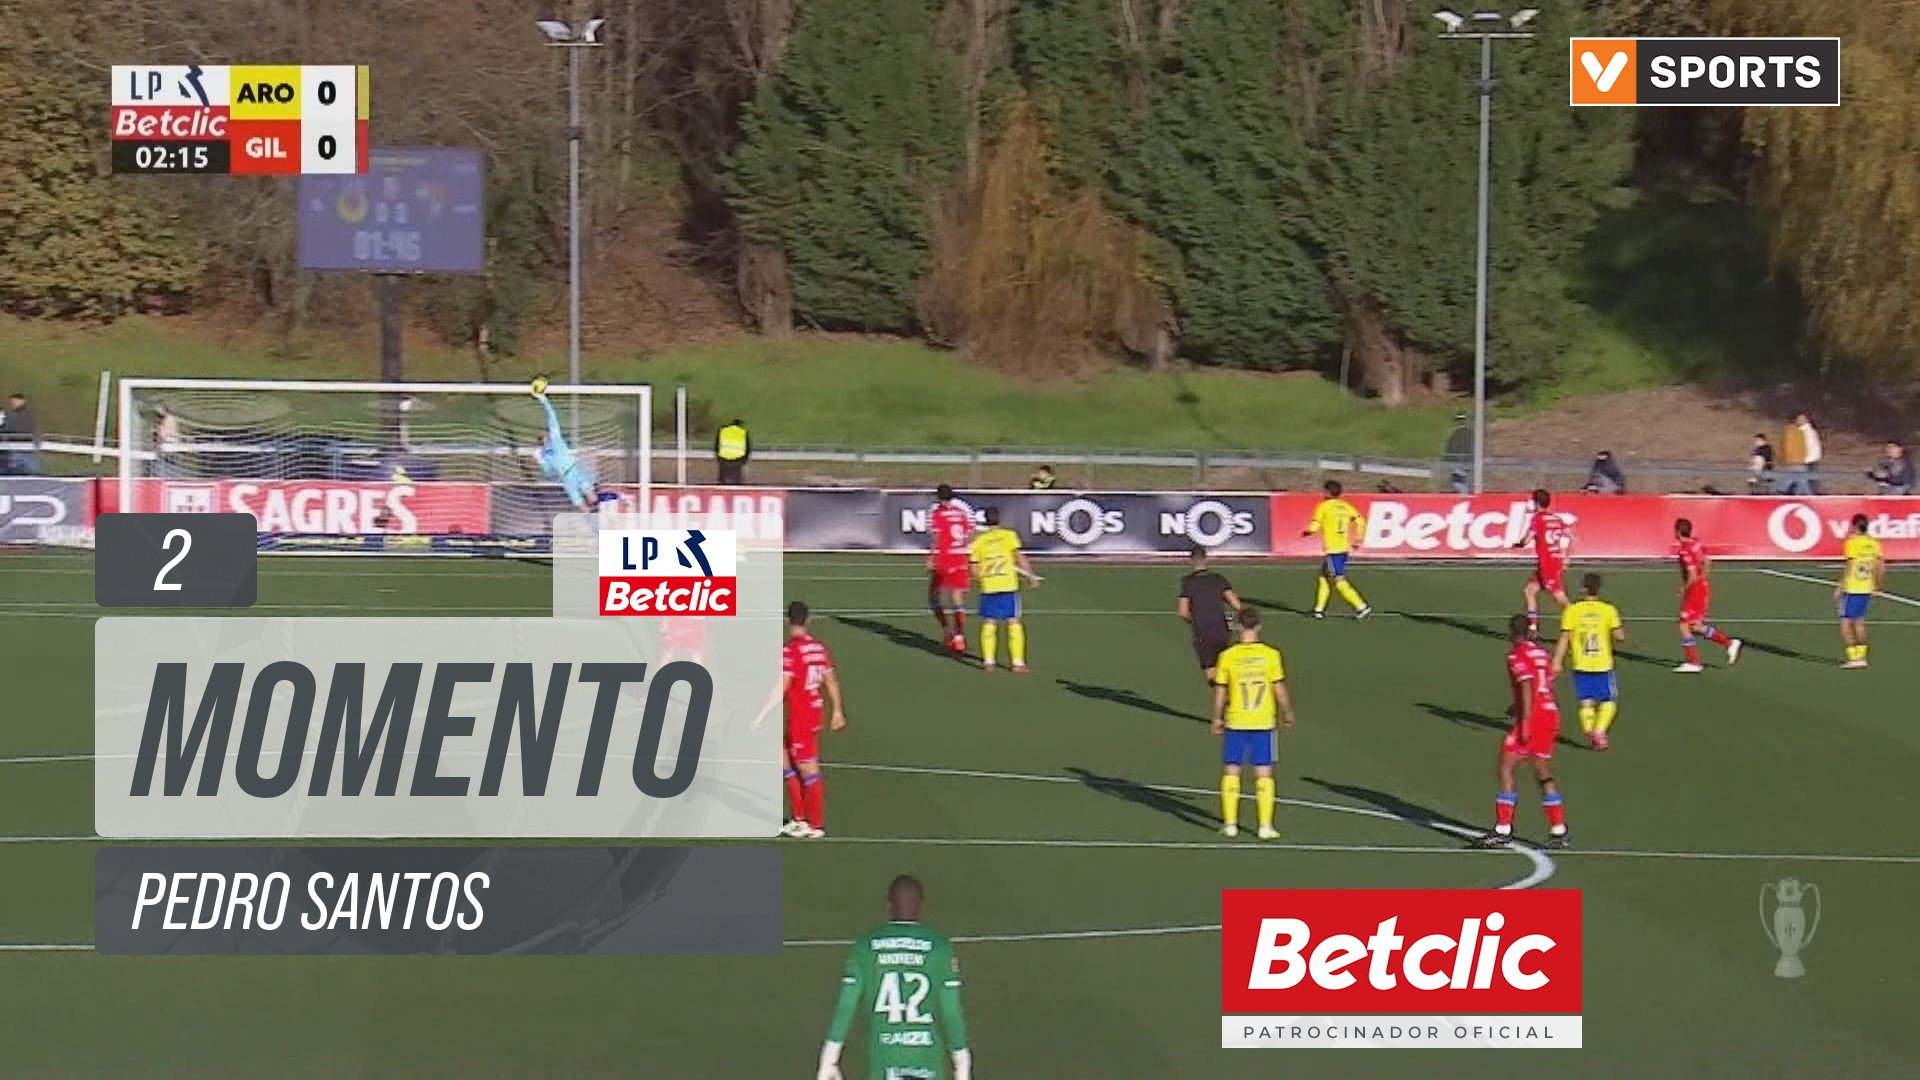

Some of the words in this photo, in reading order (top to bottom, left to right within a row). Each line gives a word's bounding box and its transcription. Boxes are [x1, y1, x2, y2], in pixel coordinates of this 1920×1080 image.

[228, 484, 418, 536] SAGRES
[1031, 497, 1125, 546] NOS
[1160, 498, 1255, 548] NOS
[1238, 681, 1267, 711] 17
[874, 971, 934, 1024] 42
